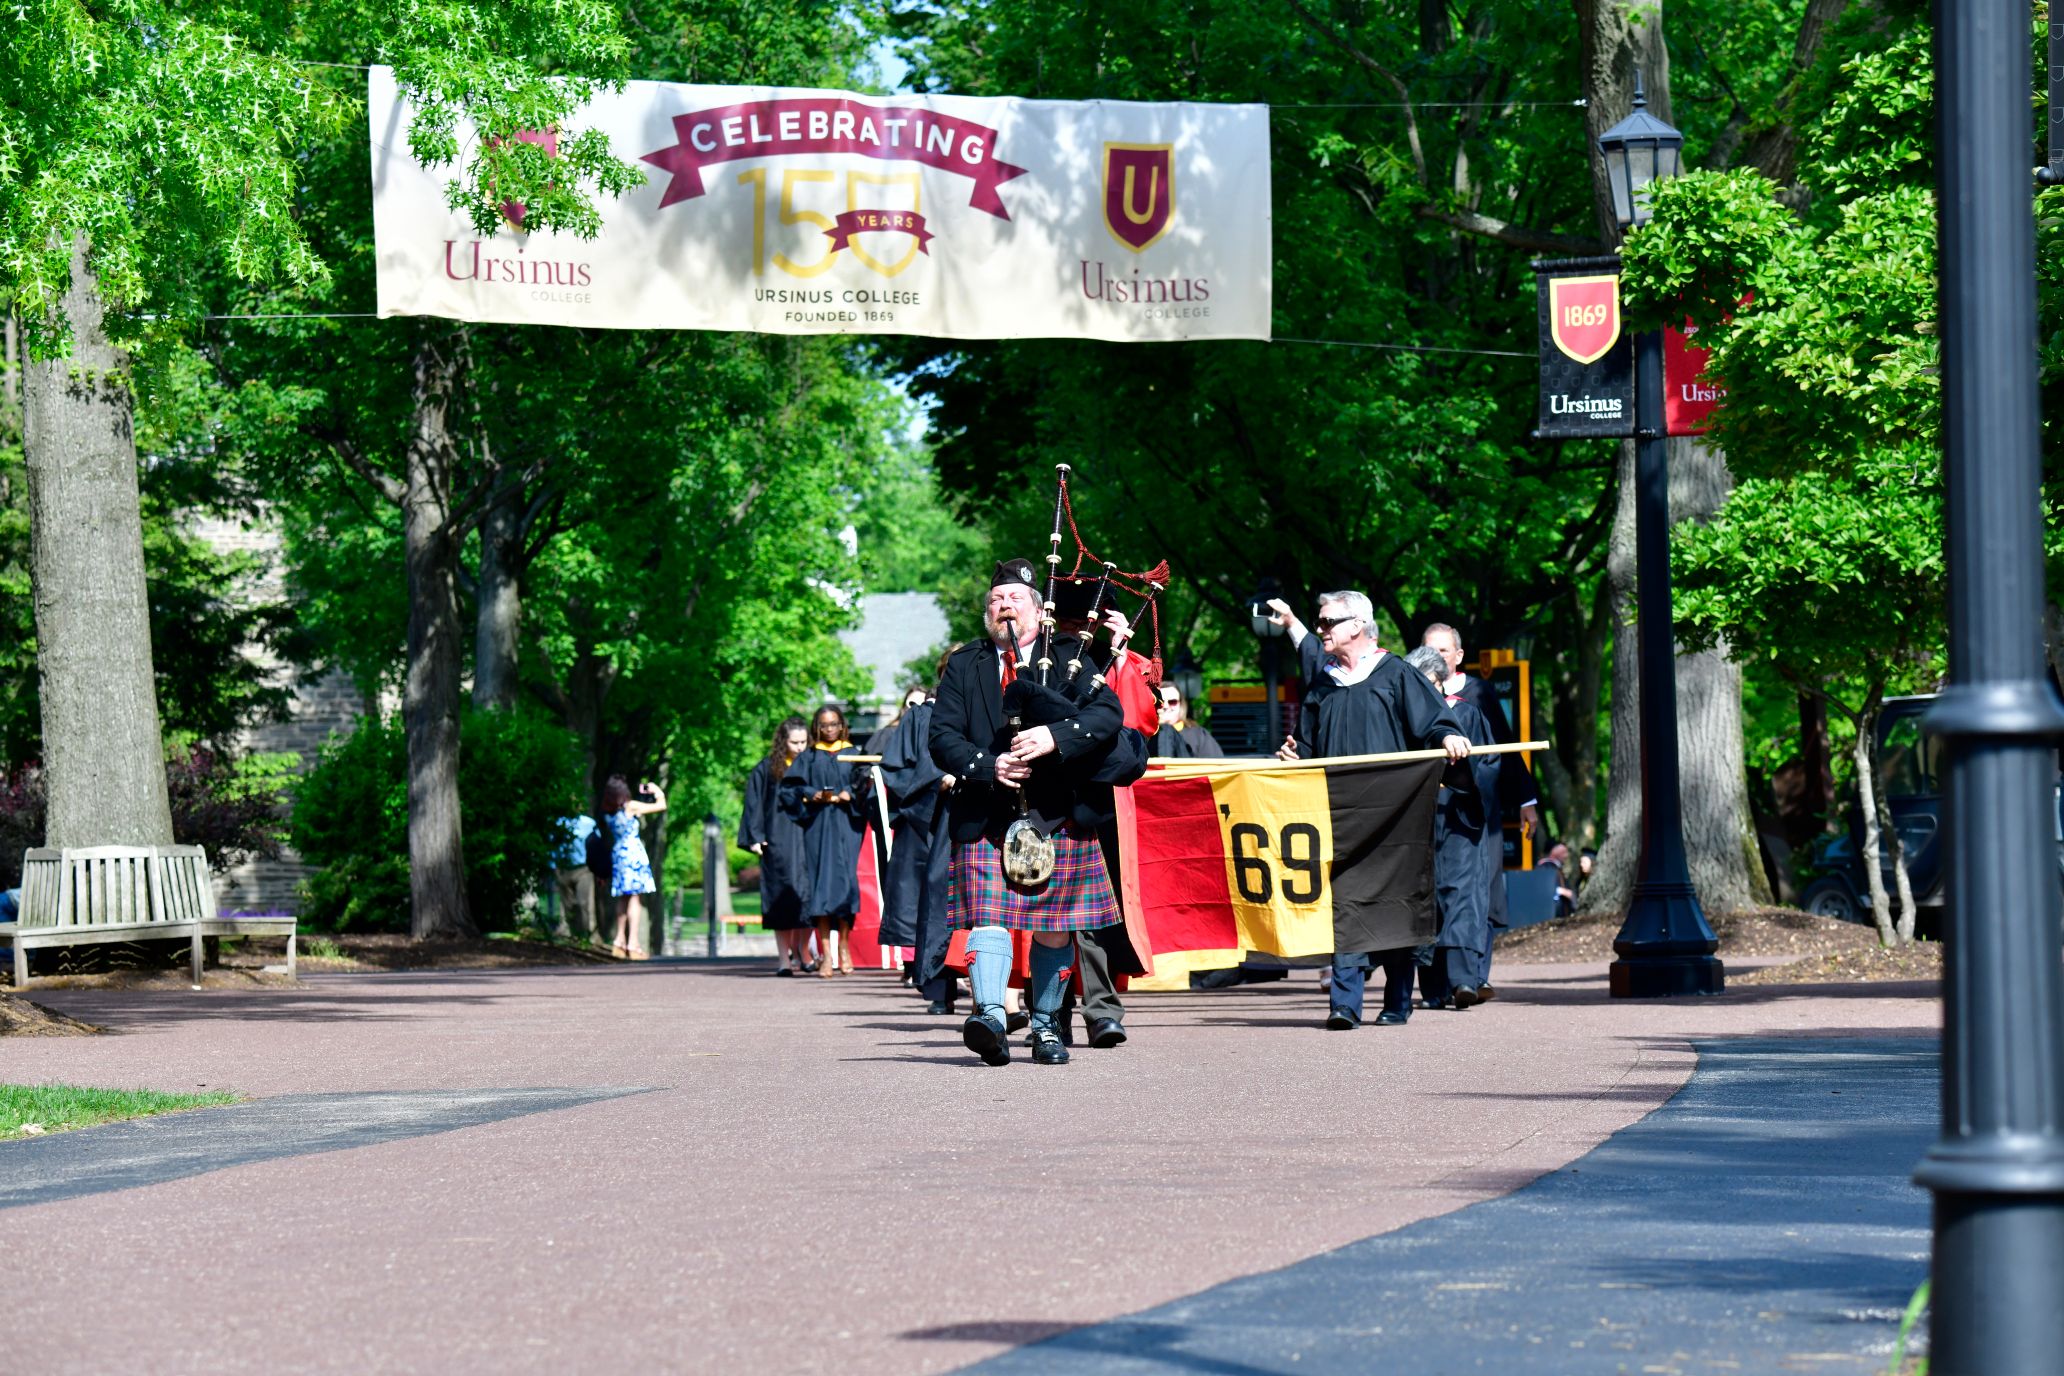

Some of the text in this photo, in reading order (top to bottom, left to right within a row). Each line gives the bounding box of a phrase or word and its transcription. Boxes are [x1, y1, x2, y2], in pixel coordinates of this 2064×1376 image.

[690, 110, 984, 165] CELEBRATING
[1122, 165, 1158, 225] U
[857, 214, 914, 229] YEARS
[443, 240, 592, 287] Ursinus
[1080, 260, 1210, 304] Ursinus
[530, 290, 592, 304] COLLEGE
[755, 288, 920, 305] URSINUS COLLEGE
[785, 311, 894, 322] FOUNDED 1869
[1144, 306, 1211, 319] COLLEGE
[1564, 304, 1607, 327] 1869
[1550, 395, 1622, 414] Ursinus
